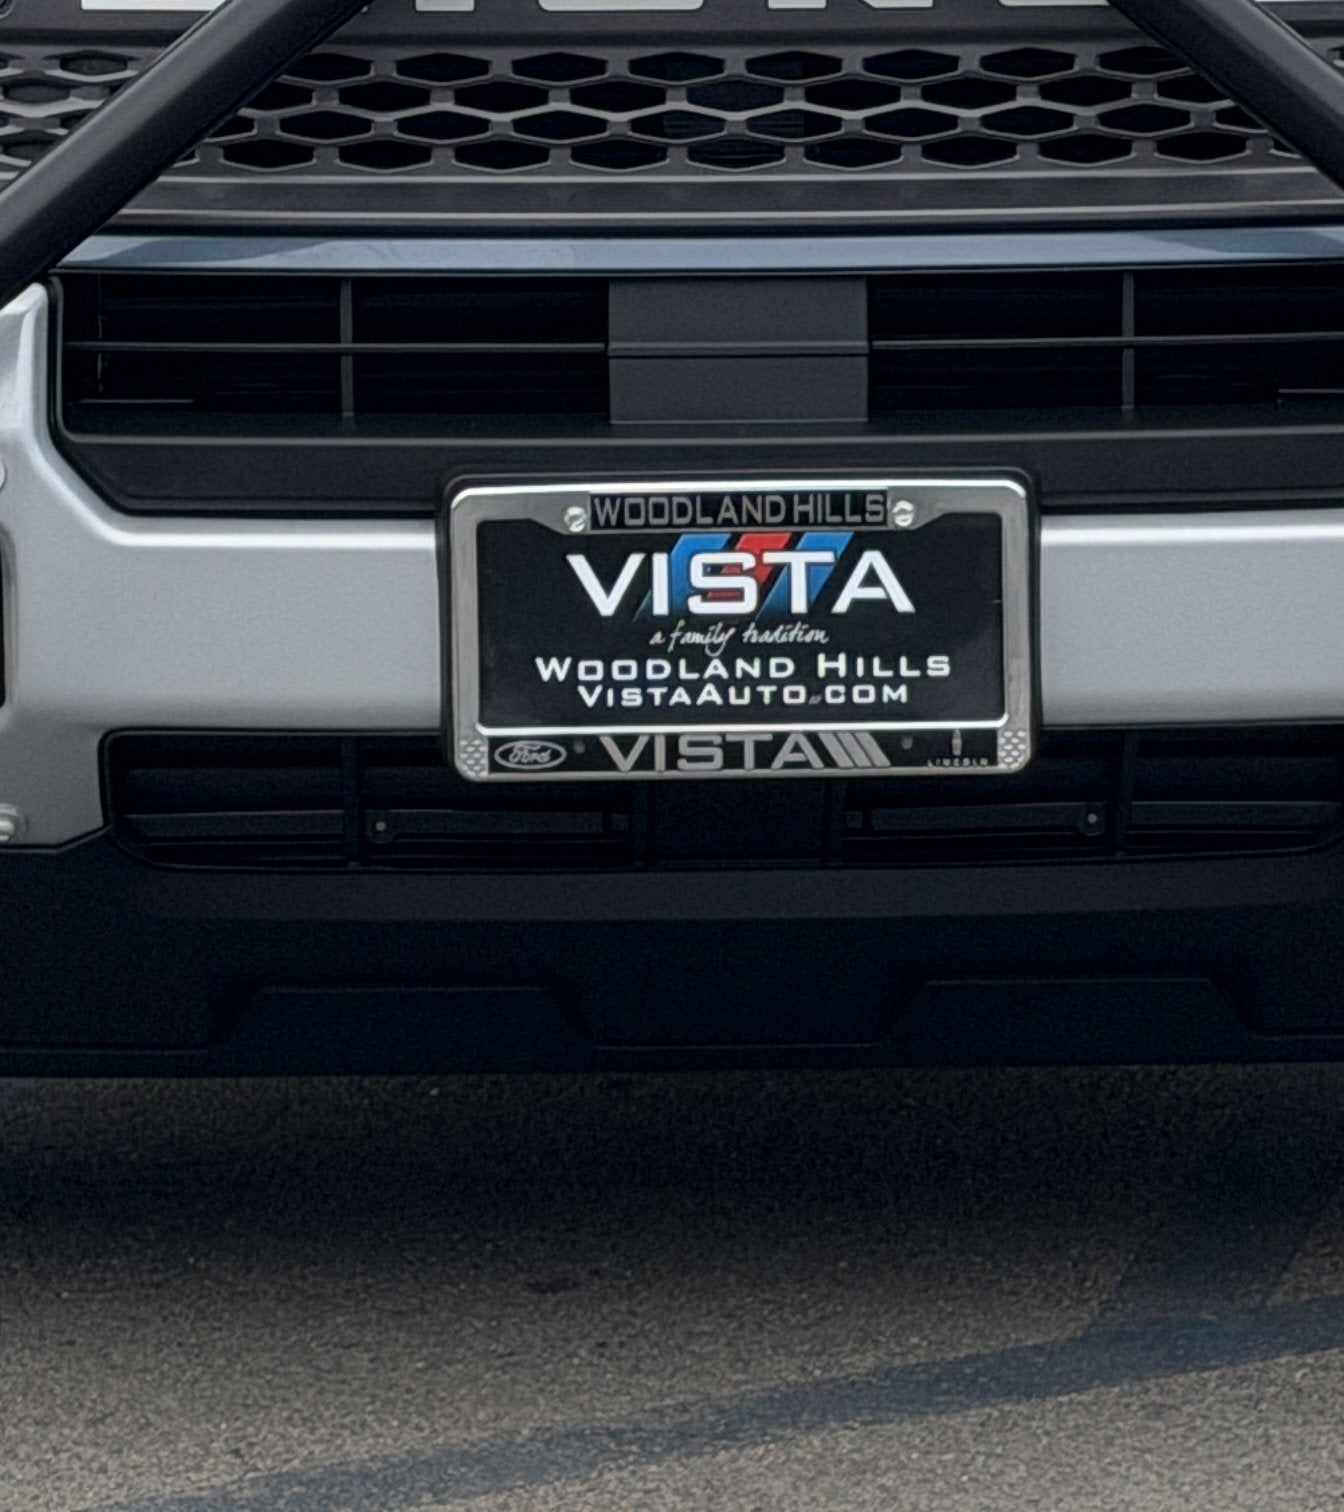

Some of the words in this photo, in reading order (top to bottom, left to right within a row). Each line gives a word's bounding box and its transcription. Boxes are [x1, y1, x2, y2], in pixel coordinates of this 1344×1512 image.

[595, 493, 787, 528] WOODLAND
[793, 492, 886, 526] HILLS
[565, 548, 917, 617] VISTA
[667, 619, 737, 658] family
[742, 619, 830, 645] tradition
[535, 655, 795, 683] WOODLAND
[816, 652, 952, 678] HILLS
[508, 743, 553, 764] Ford
[599, 732, 826, 773] VISTA
